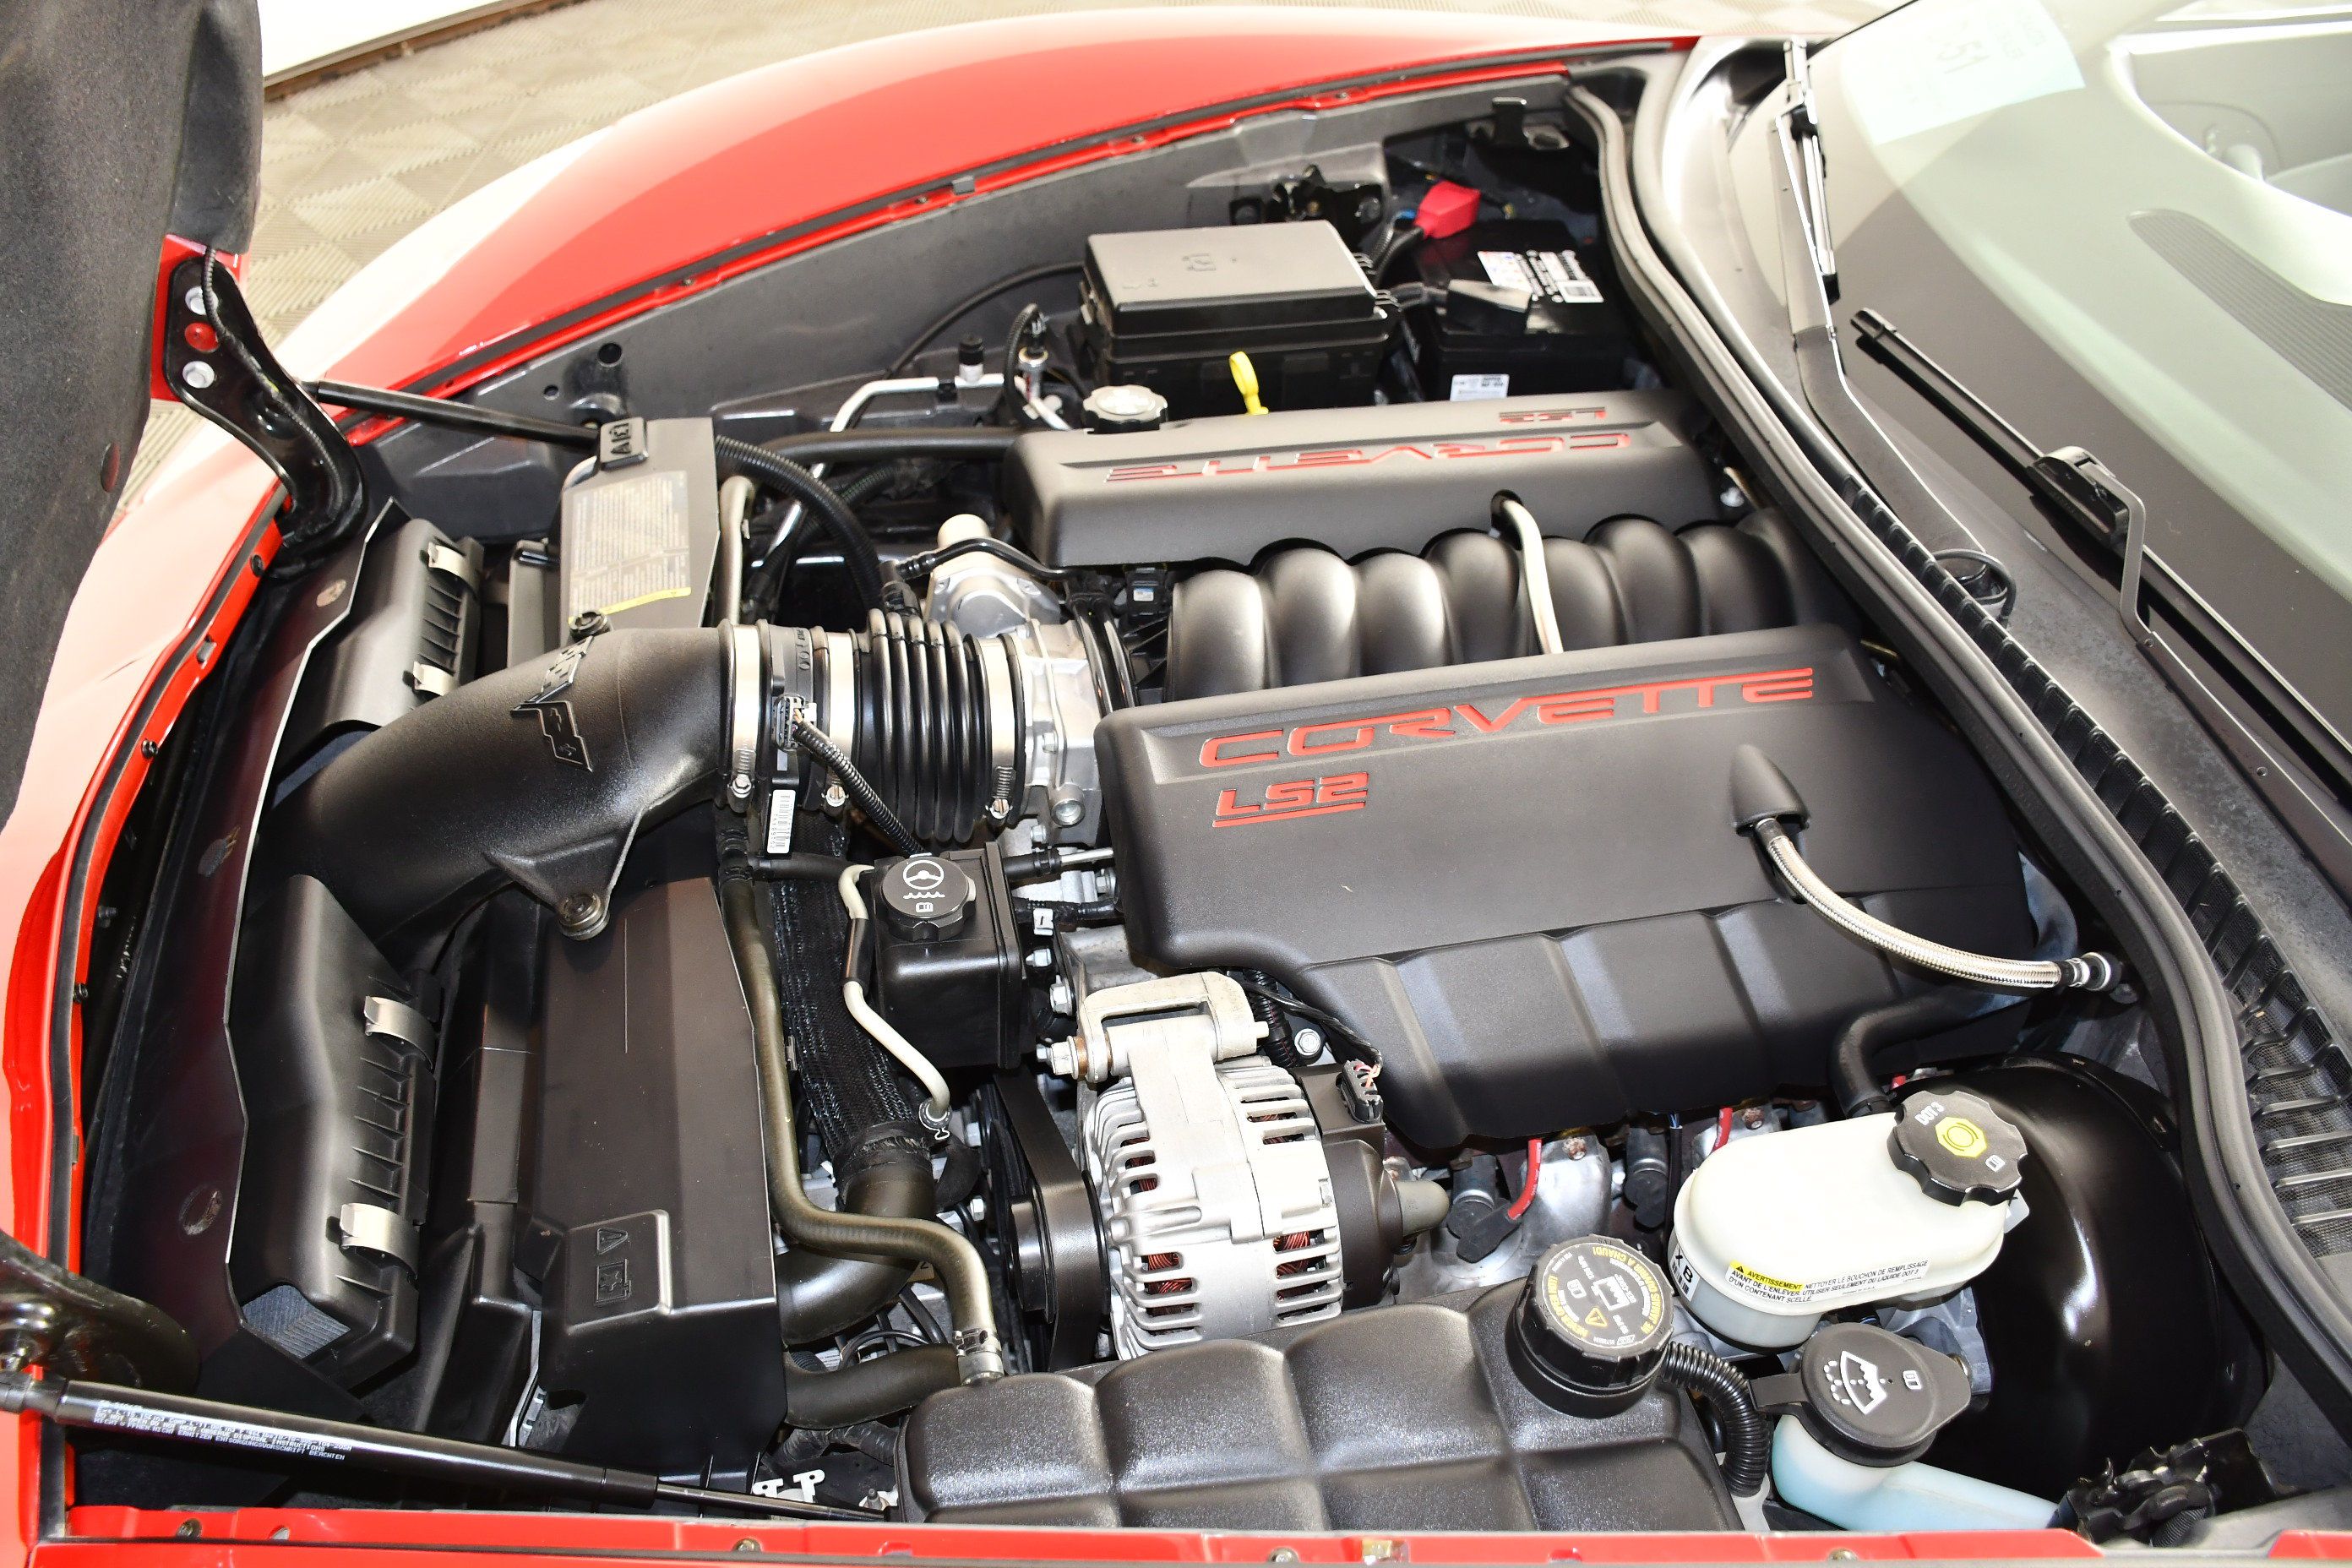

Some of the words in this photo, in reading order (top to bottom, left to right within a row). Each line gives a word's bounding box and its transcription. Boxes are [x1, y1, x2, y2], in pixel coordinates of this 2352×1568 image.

[1199, 668, 1814, 768] CORVETTE
[1215, 772, 1369, 818] LS2
[1914, 1106, 1939, 1126] DOT
[1931, 1101, 1945, 1113] 3
[1729, 1276, 1745, 1288] D'UN
[1745, 1285, 1786, 1302] CONTENANT
[1731, 1270, 1753, 1284] AVANT
[1753, 1280, 1763, 1289] DE
[1802, 1286, 1831, 1297] UTILISER
[1831, 1279, 1867, 1292] SEULEMENT
[1747, 1271, 1803, 1291] AVERTISSEMENT
[1805, 1278, 1837, 1290] NETTOYER
[1847, 1270, 1876, 1282] BOUCHON
[1887, 1260, 1929, 1274] REMPLISSAGE
[308, 1450, 346, 1461] BEACHTEN
